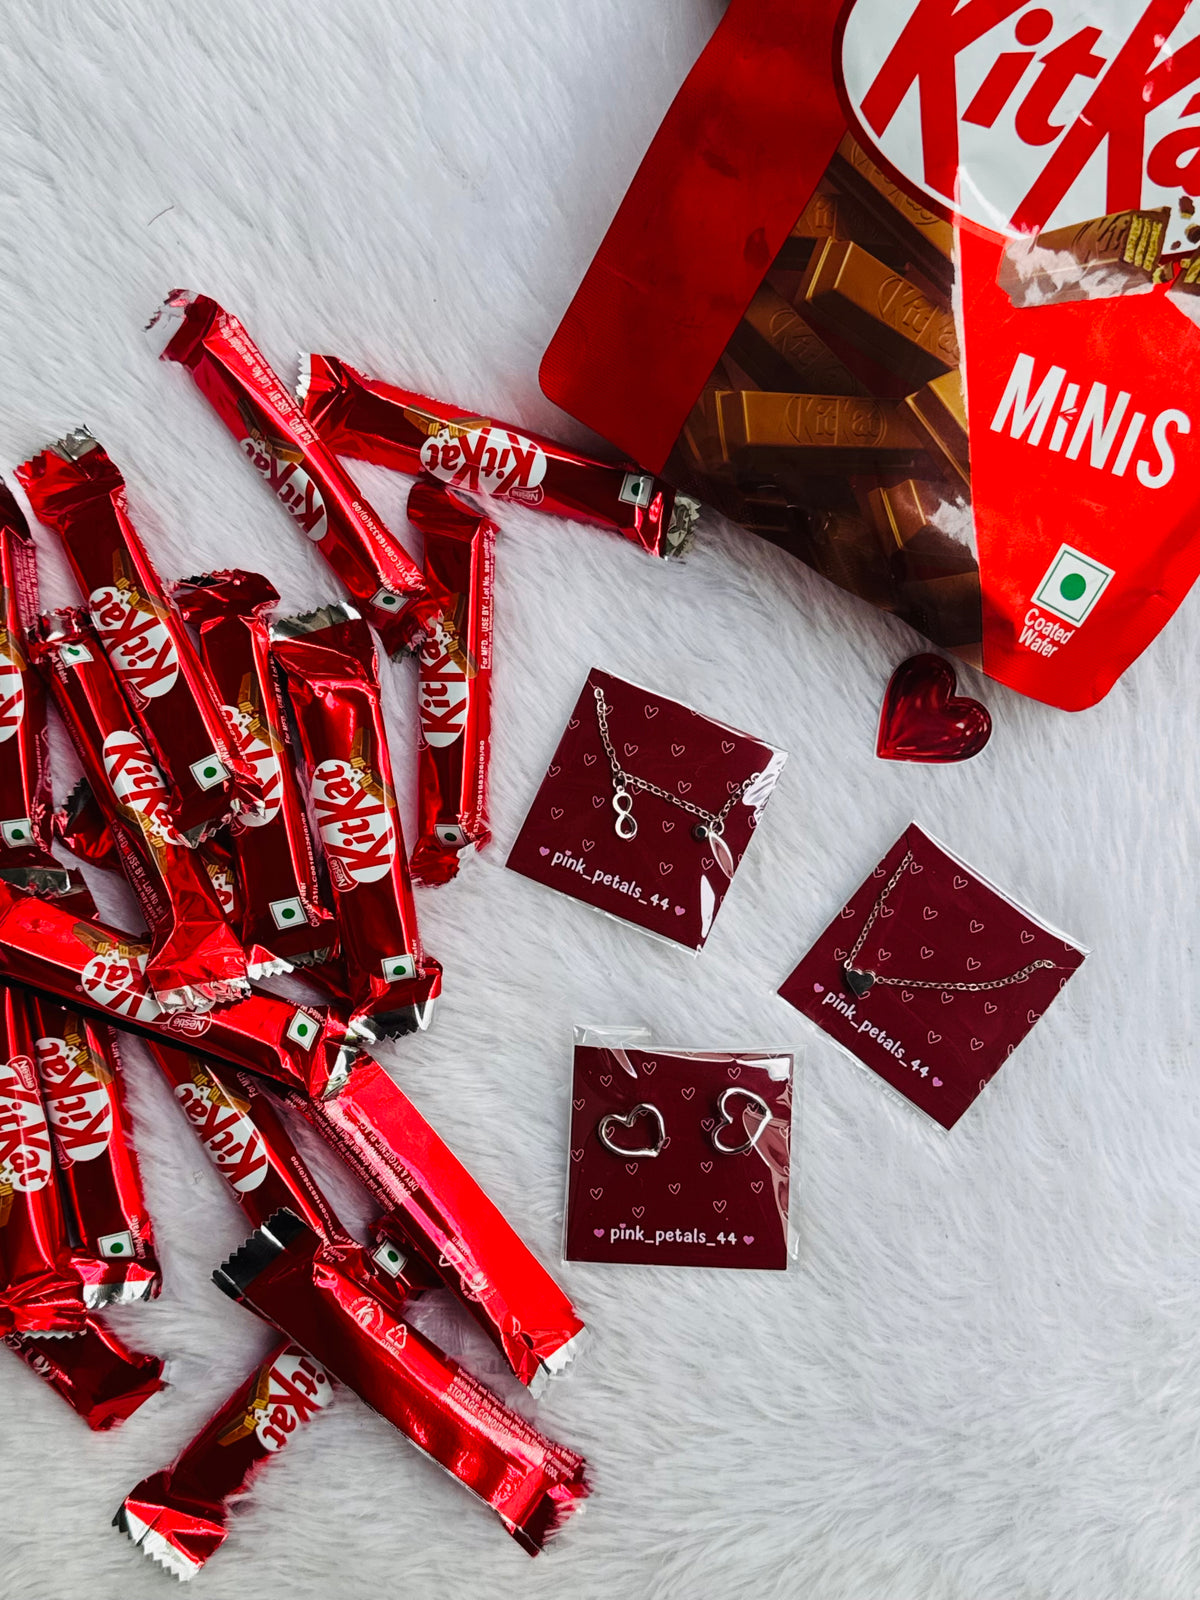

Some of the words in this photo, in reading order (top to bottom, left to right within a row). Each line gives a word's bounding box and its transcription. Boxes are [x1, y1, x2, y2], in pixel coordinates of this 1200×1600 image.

[226, 333, 247, 357] under
[241, 351, 255, 366] see
[256, 374, 272, 389] Lot
[267, 388, 282, 402] BY
[273, 397, 292, 416] USE
[990, 353, 1191, 489] MINIS
[298, 430, 314, 446] For
[425, 427, 538, 494] KitKat
[27, 557, 37, 583] STORE
[481, 604, 488, 615] BY
[90, 591, 177, 690] KitKat
[1024, 608, 1076, 645] Coated
[1018, 625, 1059, 658] Wafer
[315, 764, 394, 871] KitKat
[125, 851, 140, 869] USE
[133, 866, 146, 878] BY
[141, 880, 154, 895] Lot
[551, 850, 669, 910] pink_petals_44
[822, 992, 929, 1078] pink_petals_44
[38, 1041, 110, 1150] KitKat
[245, 1083, 258, 1098] For
[179, 1088, 266, 1185] KitKat
[374, 1138, 403, 1172] HYGIENIC
[366, 1178, 377, 1190] and
[399, 1169, 408, 1178] &
[403, 1174, 419, 1192] DRY
[127, 1213, 142, 1238] Wafer
[611, 1223, 737, 1246] pink_petals_44
[262, 1350, 325, 1449] itKat
[445, 1383, 479, 1412] STORAGE
[476, 1407, 514, 1440] CONDITION
[543, 1464, 561, 1480] COOL
